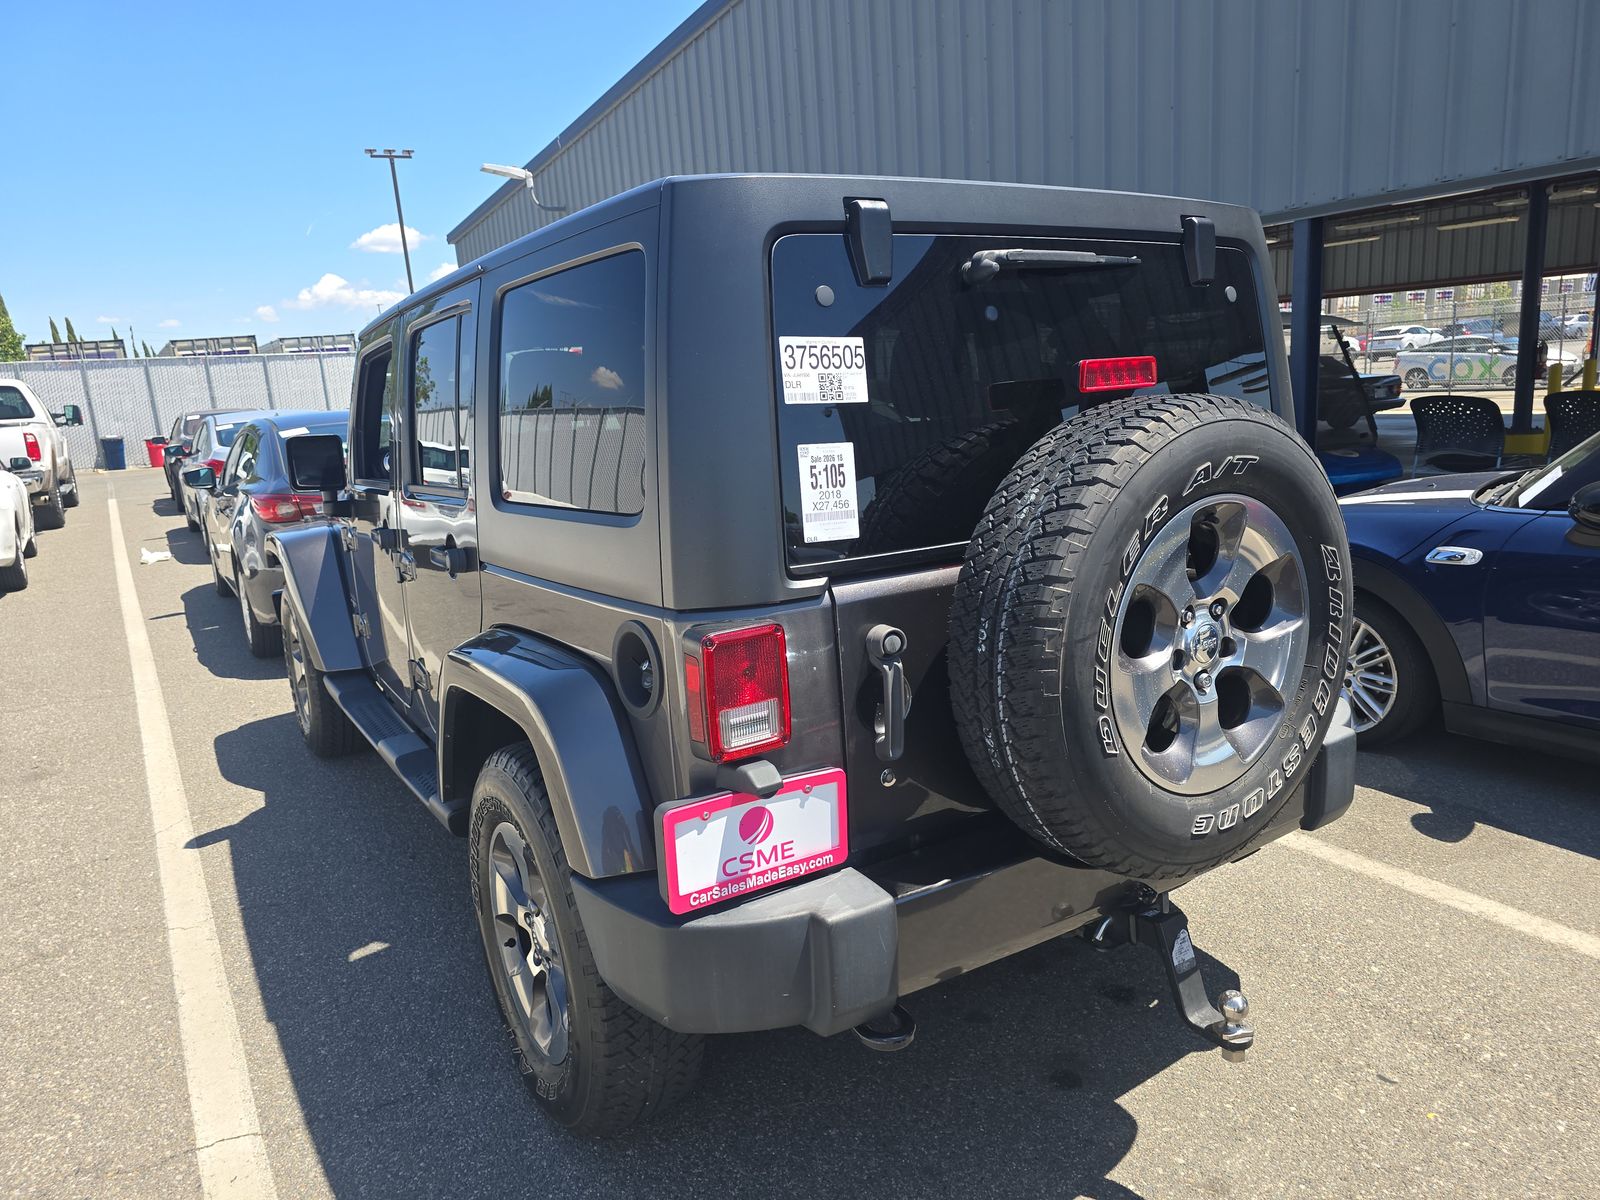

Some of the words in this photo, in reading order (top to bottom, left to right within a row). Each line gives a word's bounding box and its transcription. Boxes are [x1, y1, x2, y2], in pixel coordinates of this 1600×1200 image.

[784, 344, 865, 370] 3756505
[1427, 355, 1500, 380] COX
[785, 380, 802, 389] DLR
[810, 463, 846, 490] 5:105
[812, 499, 850, 512] X27,456
[819, 490, 842, 500] 2018
[1095, 494, 1169, 754] DUELER
[1182, 455, 1260, 497] A/T
[1190, 544, 1344, 835] BRIDGESTONE
[722, 840, 795, 877] CSME
[689, 852, 834, 906] CarSalesMadeEasy.com
